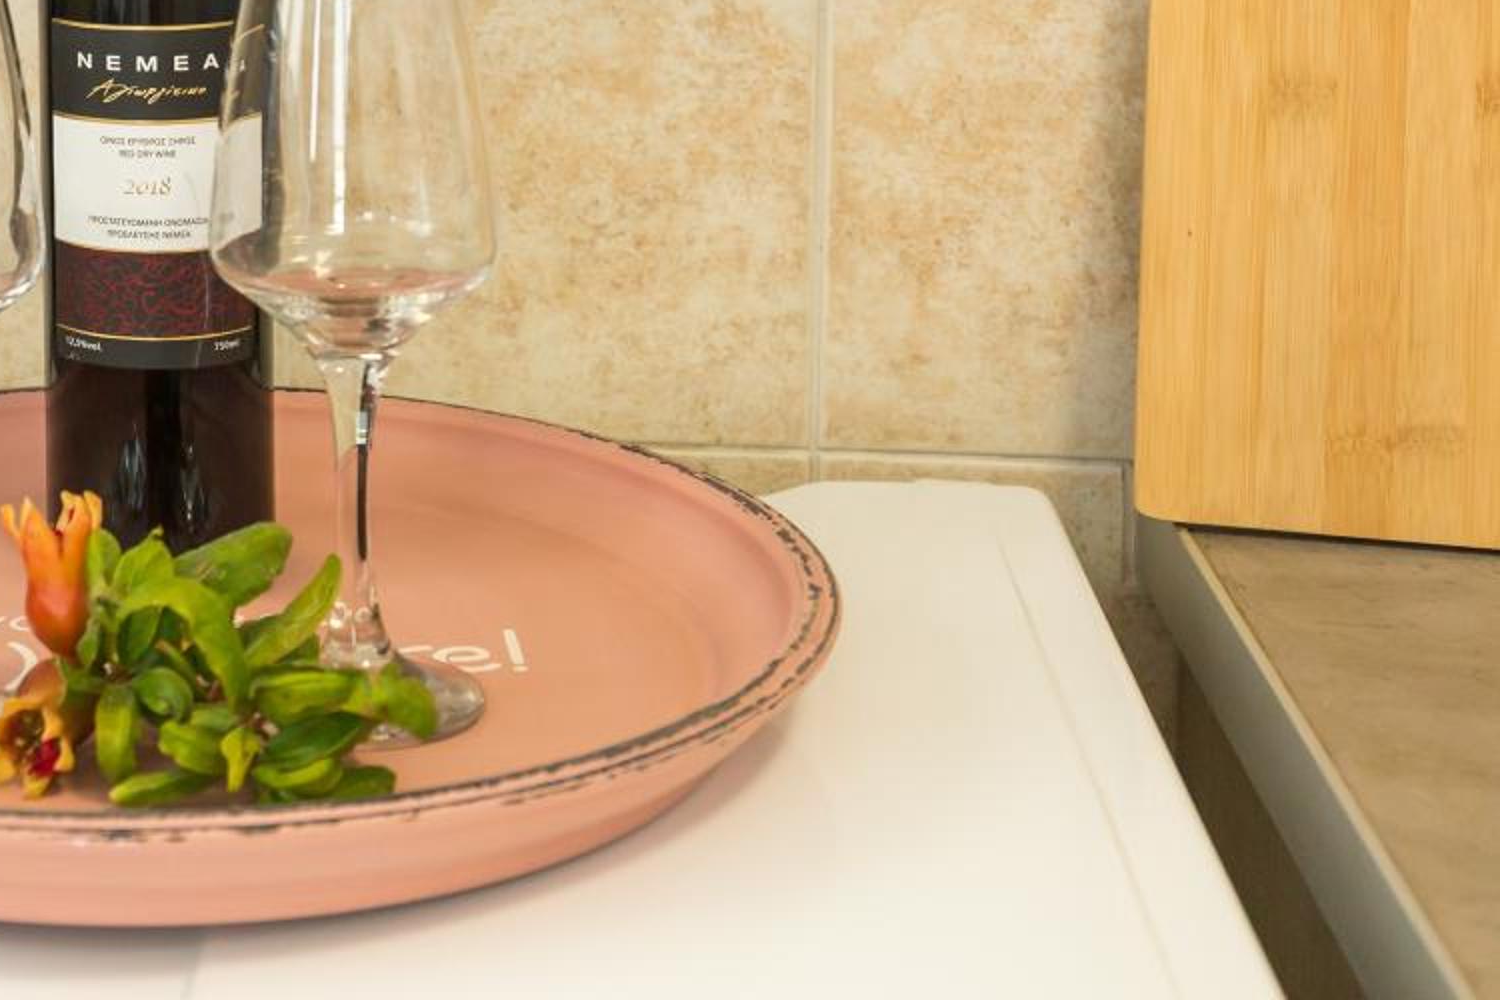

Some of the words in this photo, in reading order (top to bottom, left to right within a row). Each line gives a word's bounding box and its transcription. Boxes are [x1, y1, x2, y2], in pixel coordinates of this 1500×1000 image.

[76, 51, 220, 73] NEMEA
[137, 149, 154, 159] DRY
[123, 176, 172, 196] 2018
